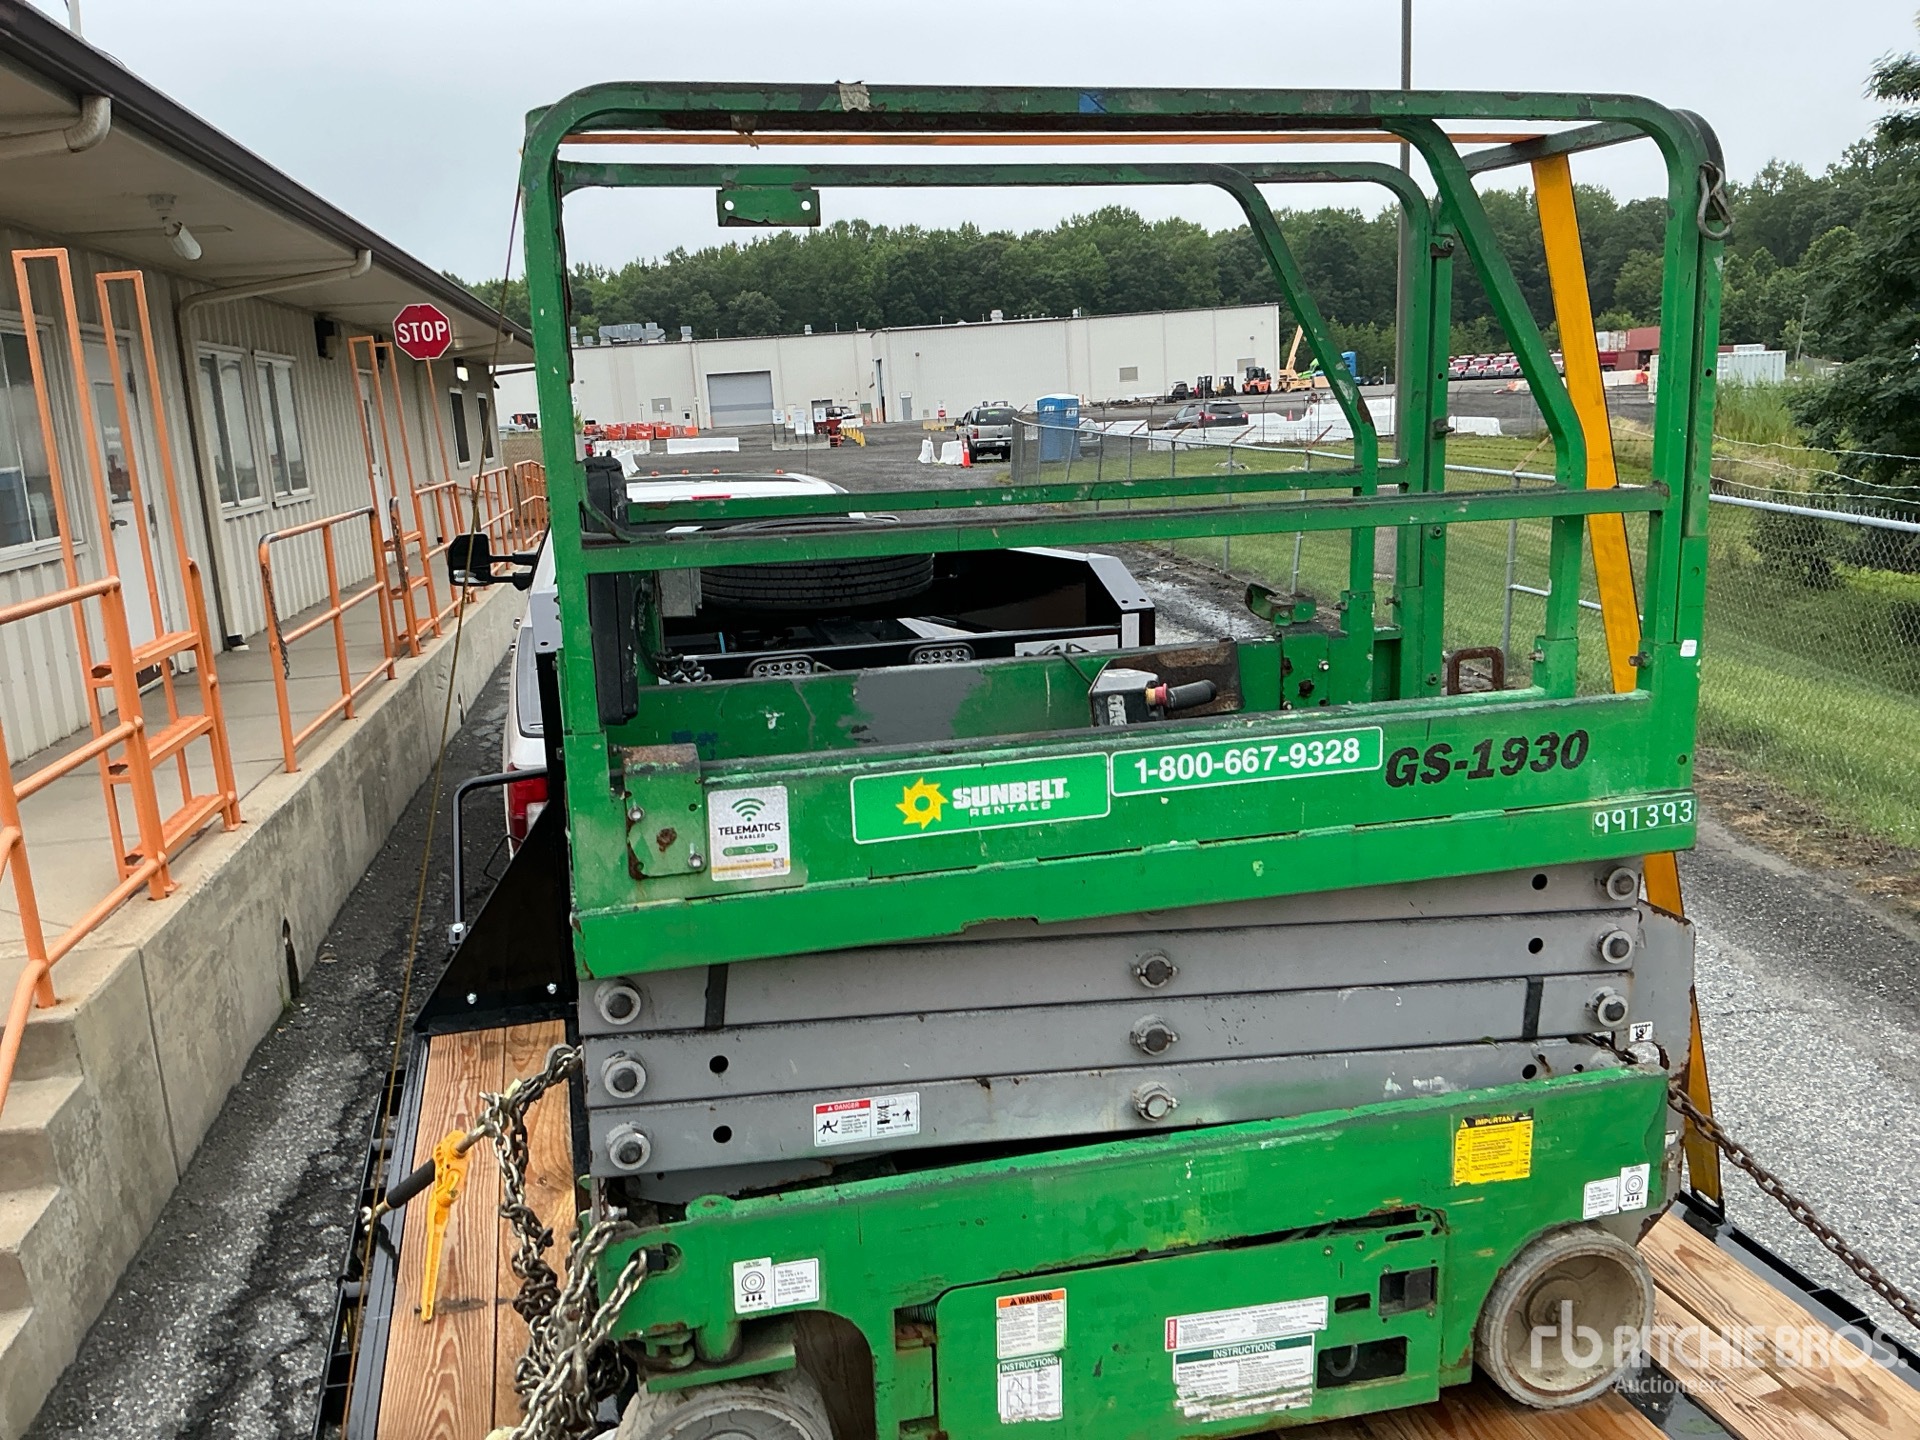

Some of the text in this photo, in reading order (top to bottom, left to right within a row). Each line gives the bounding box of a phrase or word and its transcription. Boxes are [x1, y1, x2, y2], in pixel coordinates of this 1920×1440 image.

[398, 320, 447, 344] STOP
[1134, 738, 1360, 784] 1-800-667-9328
[1385, 729, 1590, 788] GS-1930
[952, 778, 1068, 810] SUNBELT
[969, 801, 1052, 817] RENTALS
[1594, 799, 1693, 834] 991393
[718, 822, 781, 836] TELEMATICS
[834, 1101, 860, 1111] DANGER
[1018, 1293, 1053, 1305] WARNING
[1213, 1341, 1277, 1359] INSTRUCTIONS
[1001, 1356, 1058, 1372] INSTRUCTIONS
